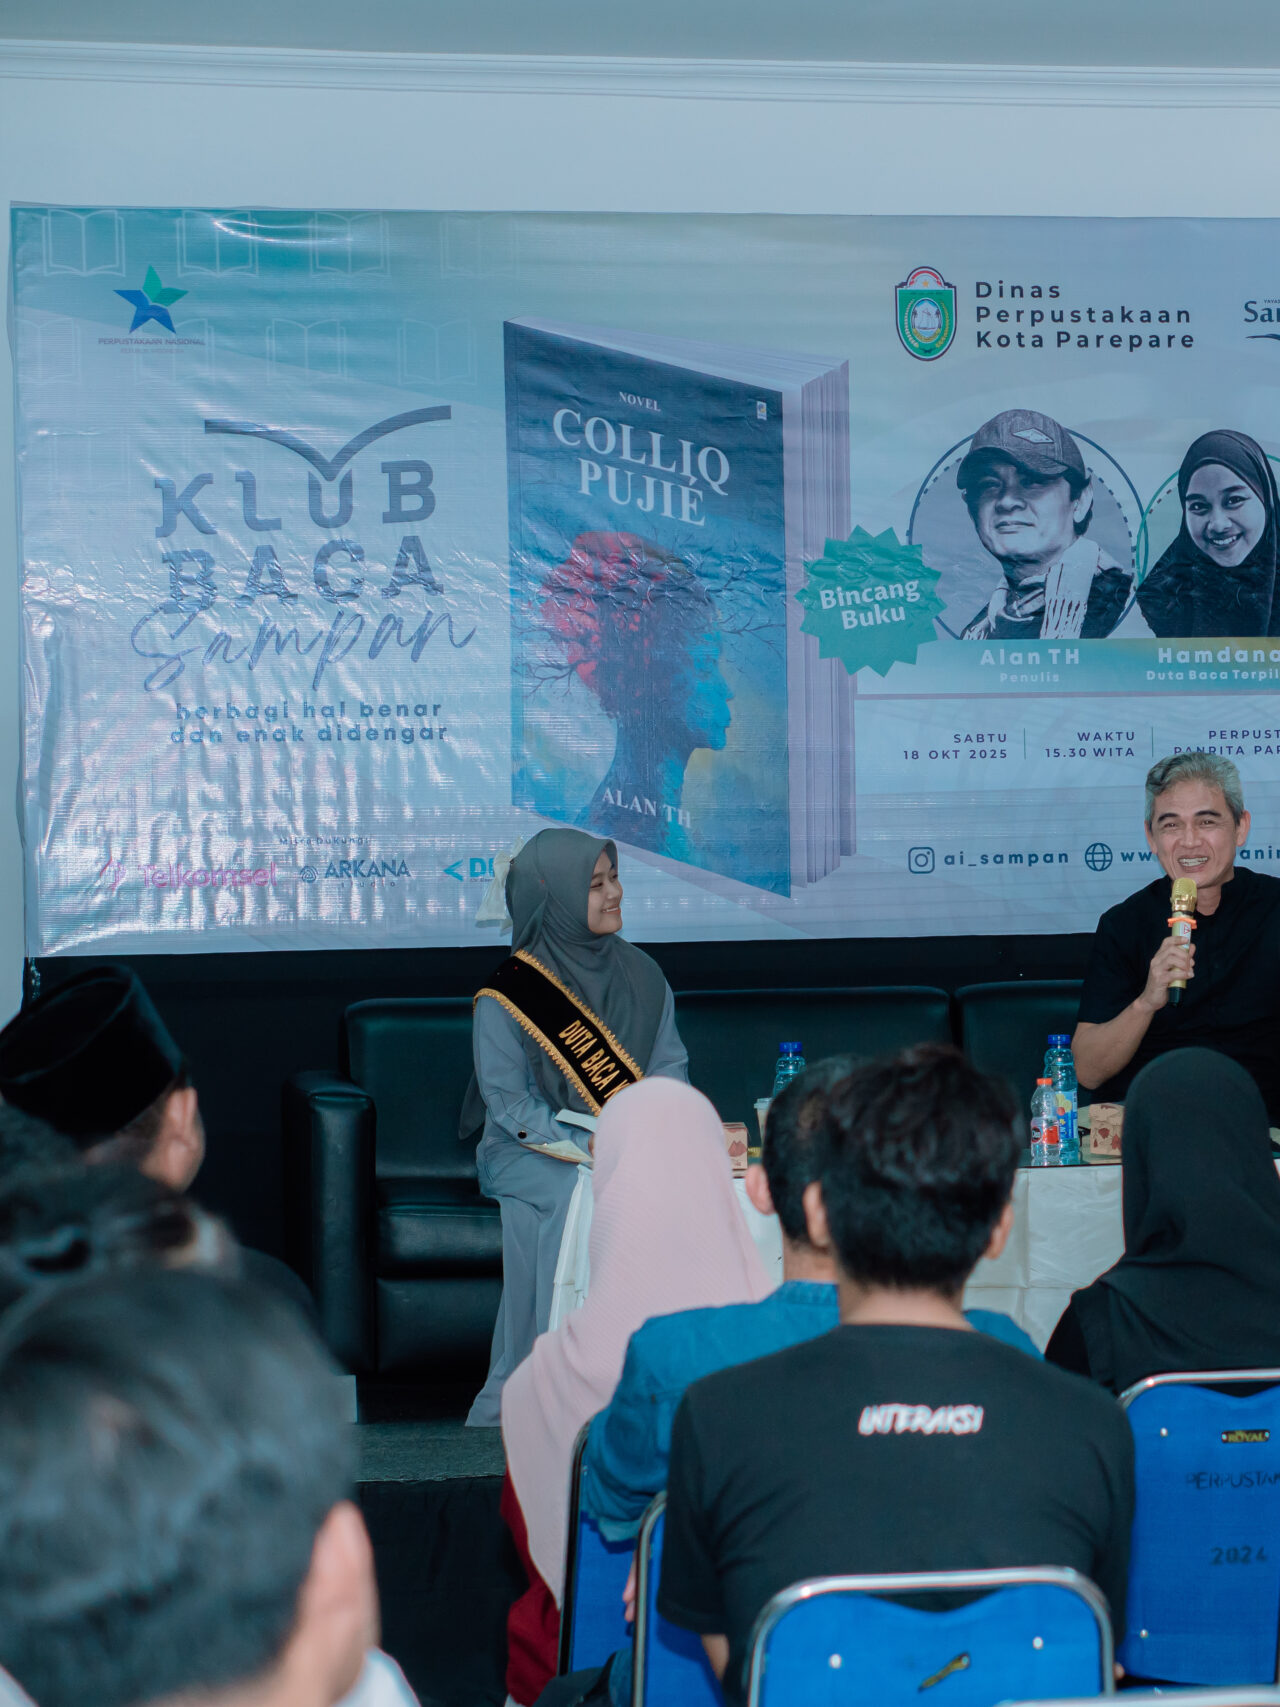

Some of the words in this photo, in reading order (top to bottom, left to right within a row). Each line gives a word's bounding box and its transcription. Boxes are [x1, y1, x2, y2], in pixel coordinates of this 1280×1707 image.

[975, 281, 1061, 298] Dinas
[975, 305, 1191, 327] Perpustakaan
[975, 331, 1044, 349] Kota
[1055, 331, 1196, 353] Parepare
[619, 391, 661, 412] NOVEL
[553, 408, 731, 496] COLLIQ
[154, 459, 437, 538] KLUB
[577, 457, 706, 527] PUJIÉ
[161, 535, 445, 614] BACA
[820, 577, 921, 612] Bincang
[842, 603, 906, 631] Buku
[131, 605, 477, 692] Sampan
[980, 648, 1041, 666] Alan
[1048, 649, 1080, 665] TH
[1000, 671, 1060, 683] Penulis
[1146, 669, 1184, 681] Duta
[1189, 669, 1229, 681] Baca
[175, 702, 289, 724] berbagi
[303, 702, 346, 719] hal
[360, 702, 442, 718] benar
[170, 727, 223, 744] dan
[237, 726, 304, 743] enak
[318, 724, 448, 745] didengar
[954, 733, 1008, 744] SABTU
[1077, 731, 1136, 742] WAKTU
[903, 749, 920, 760] 18
[928, 749, 961, 760] OKT
[969, 748, 1008, 760] 2025
[1045, 747, 1087, 759] 15.30
[1093, 747, 1135, 758] WITA
[602, 787, 657, 817] ALAN
[663, 803, 692, 829] TH
[324, 859, 412, 879] ARKANA
[943, 850, 1070, 867] ai_sampan
[137, 861, 278, 889] Telkomsel
[558, 1019, 598, 1059] DUTA
[580, 1048, 621, 1092] BACA
[857, 1403, 984, 1435] INTERAKSI
[1227, 1430, 1265, 1443] ROYAL
[1210, 1545, 1267, 1565] 2024
